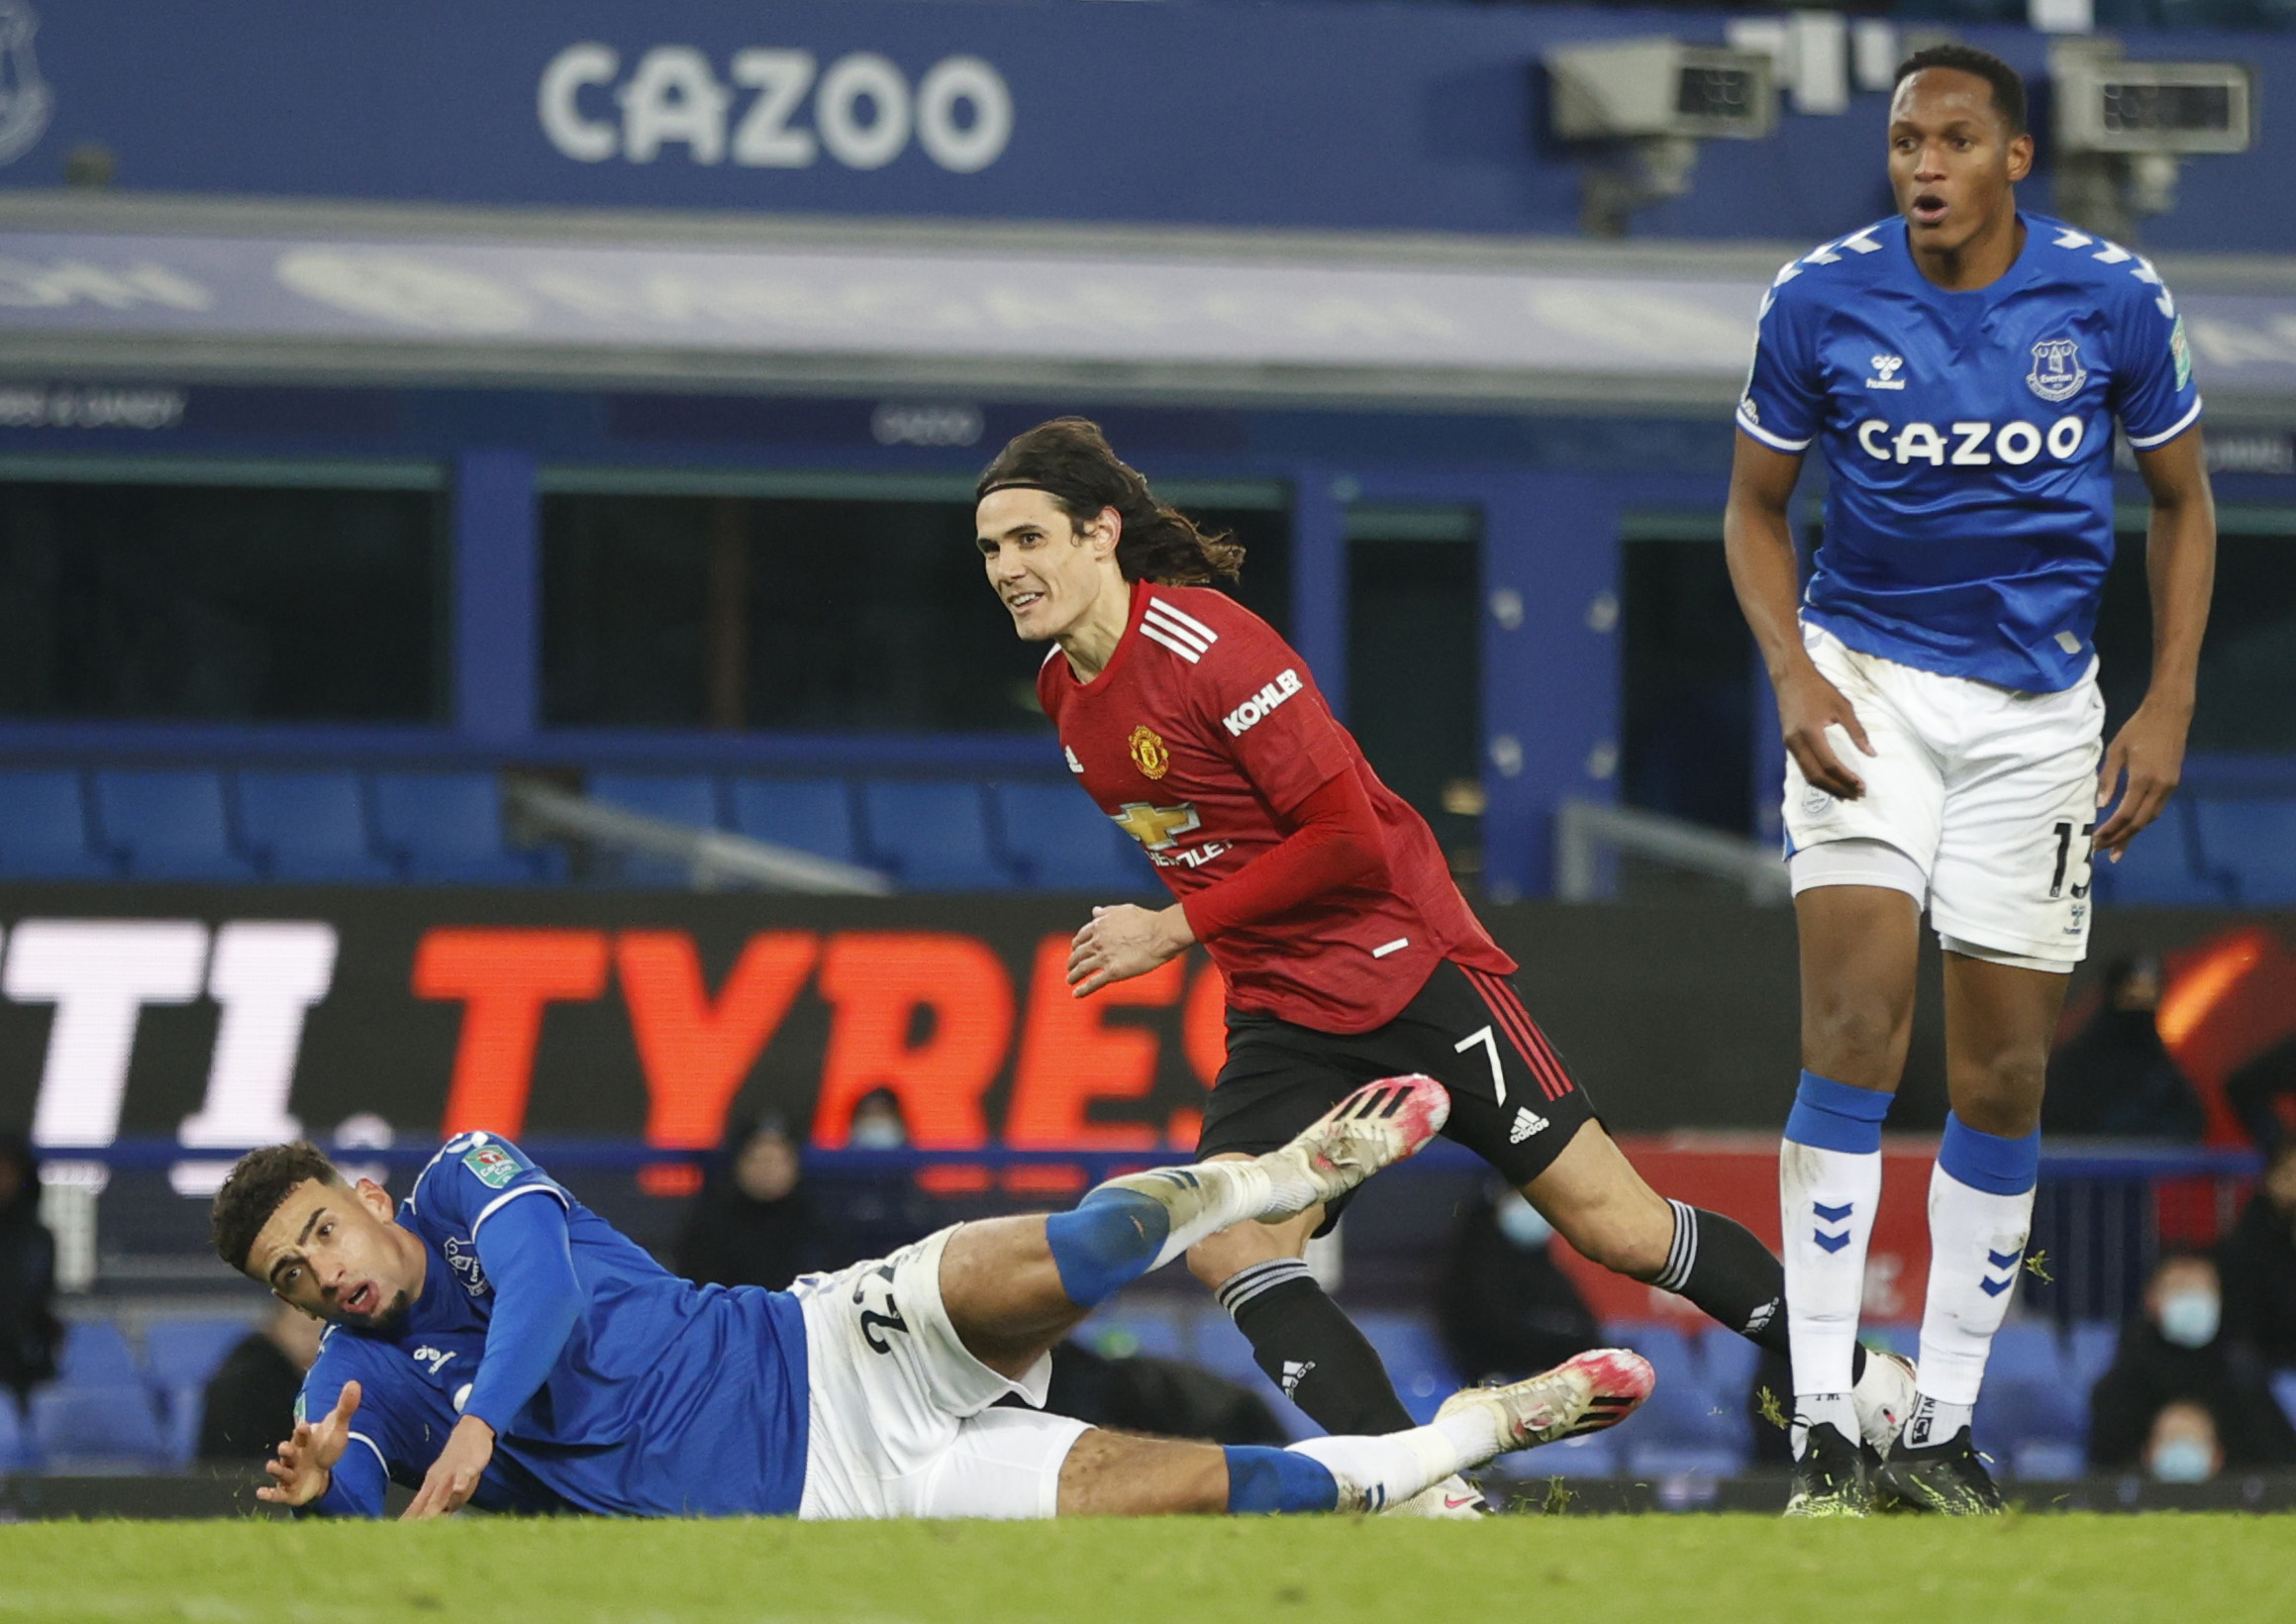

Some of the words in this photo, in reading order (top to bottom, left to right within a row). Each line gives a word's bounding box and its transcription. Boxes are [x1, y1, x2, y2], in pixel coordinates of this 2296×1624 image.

[538, 42, 1014, 173] CAZOO
[1858, 415, 2083, 466] CAZOO
[1223, 668, 1303, 737] KOHLER
[1453, 1025, 1507, 1108] 7
[1509, 1117, 1550, 1145] adidas
